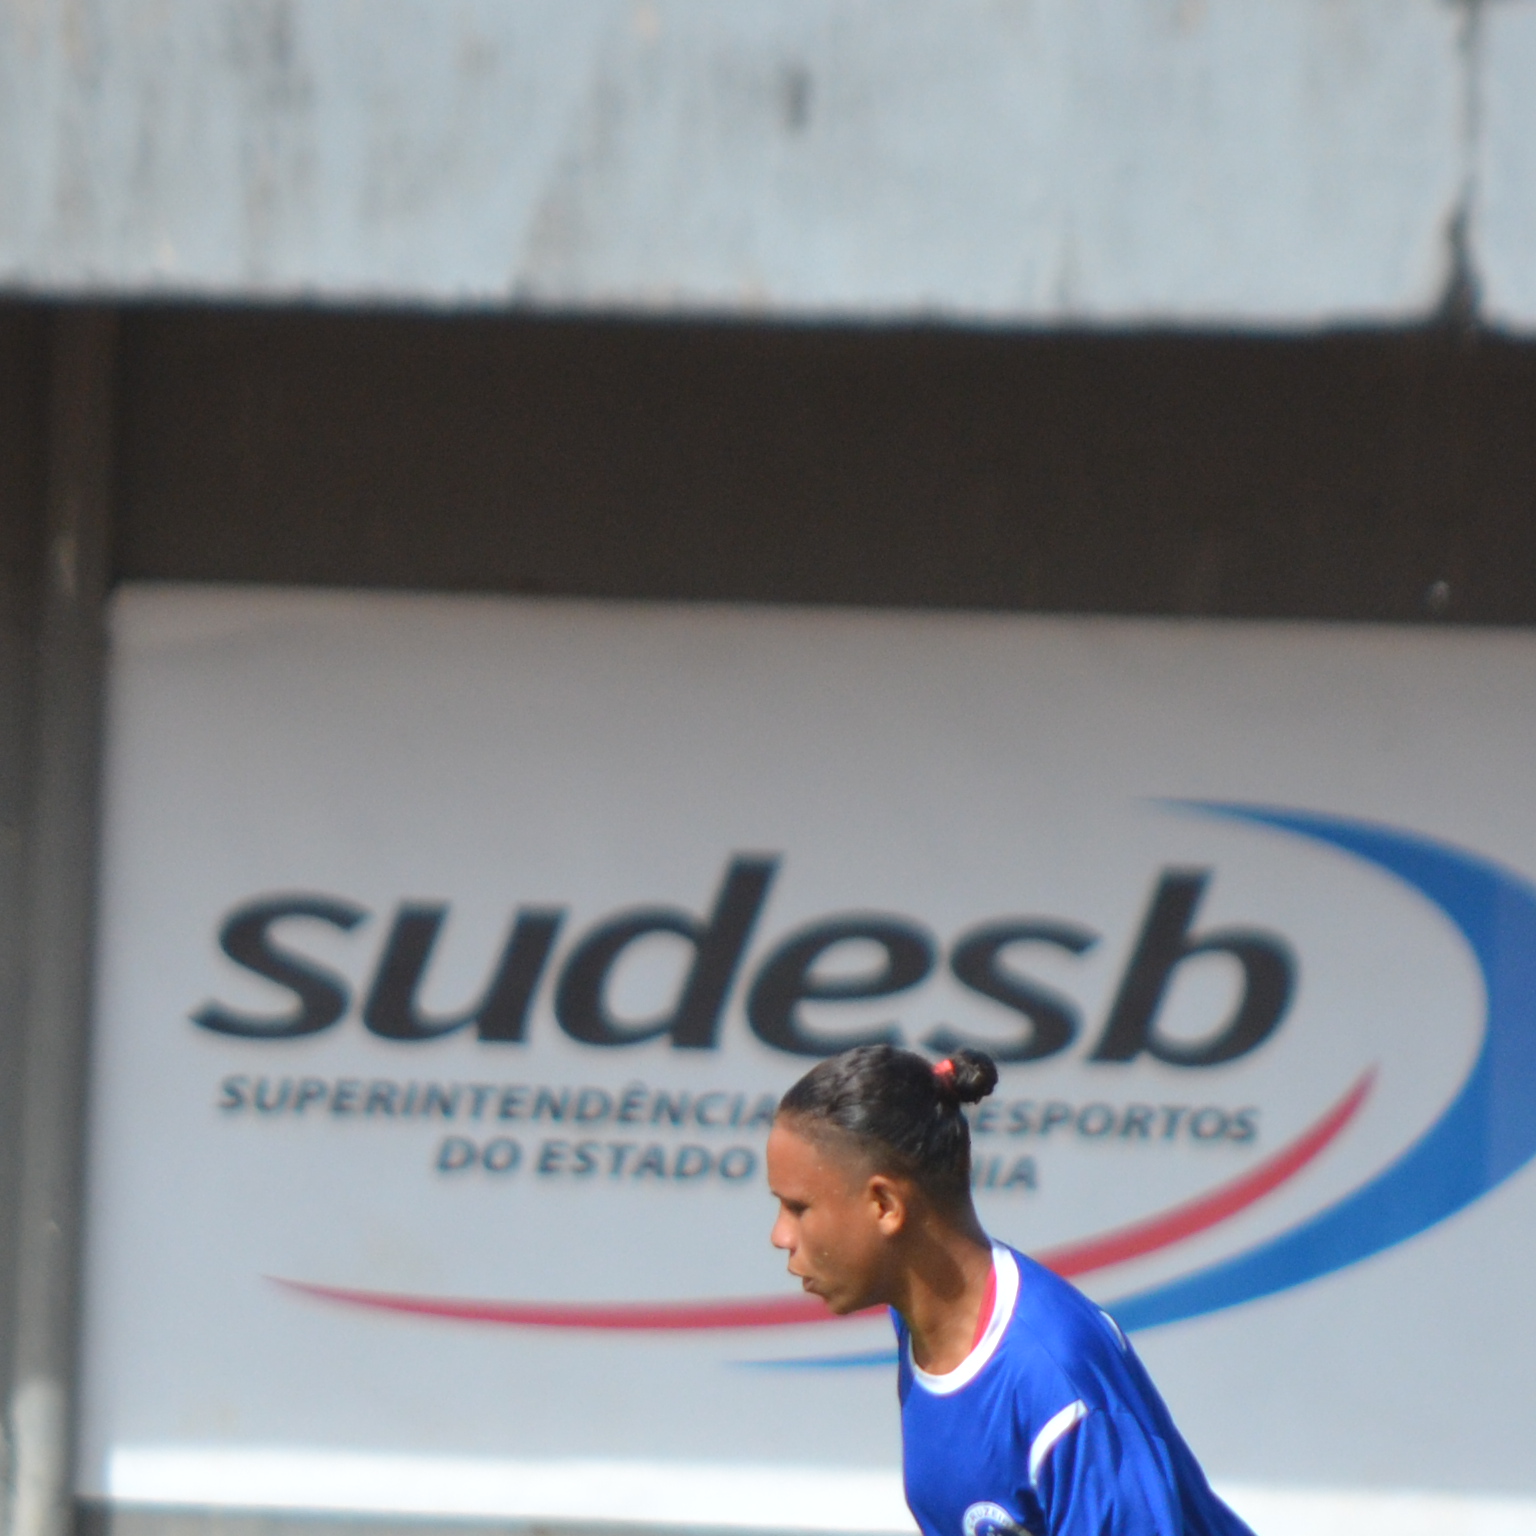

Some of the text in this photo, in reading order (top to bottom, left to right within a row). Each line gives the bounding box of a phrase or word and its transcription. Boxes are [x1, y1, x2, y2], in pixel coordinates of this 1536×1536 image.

[188, 850, 1299, 1068] sudesb
[217, 1076, 1260, 1144] SUPERINTENDÊNCIA ESPORTOS
[435, 1136, 522, 1174] DO
[536, 1140, 758, 1181] ESTADO
